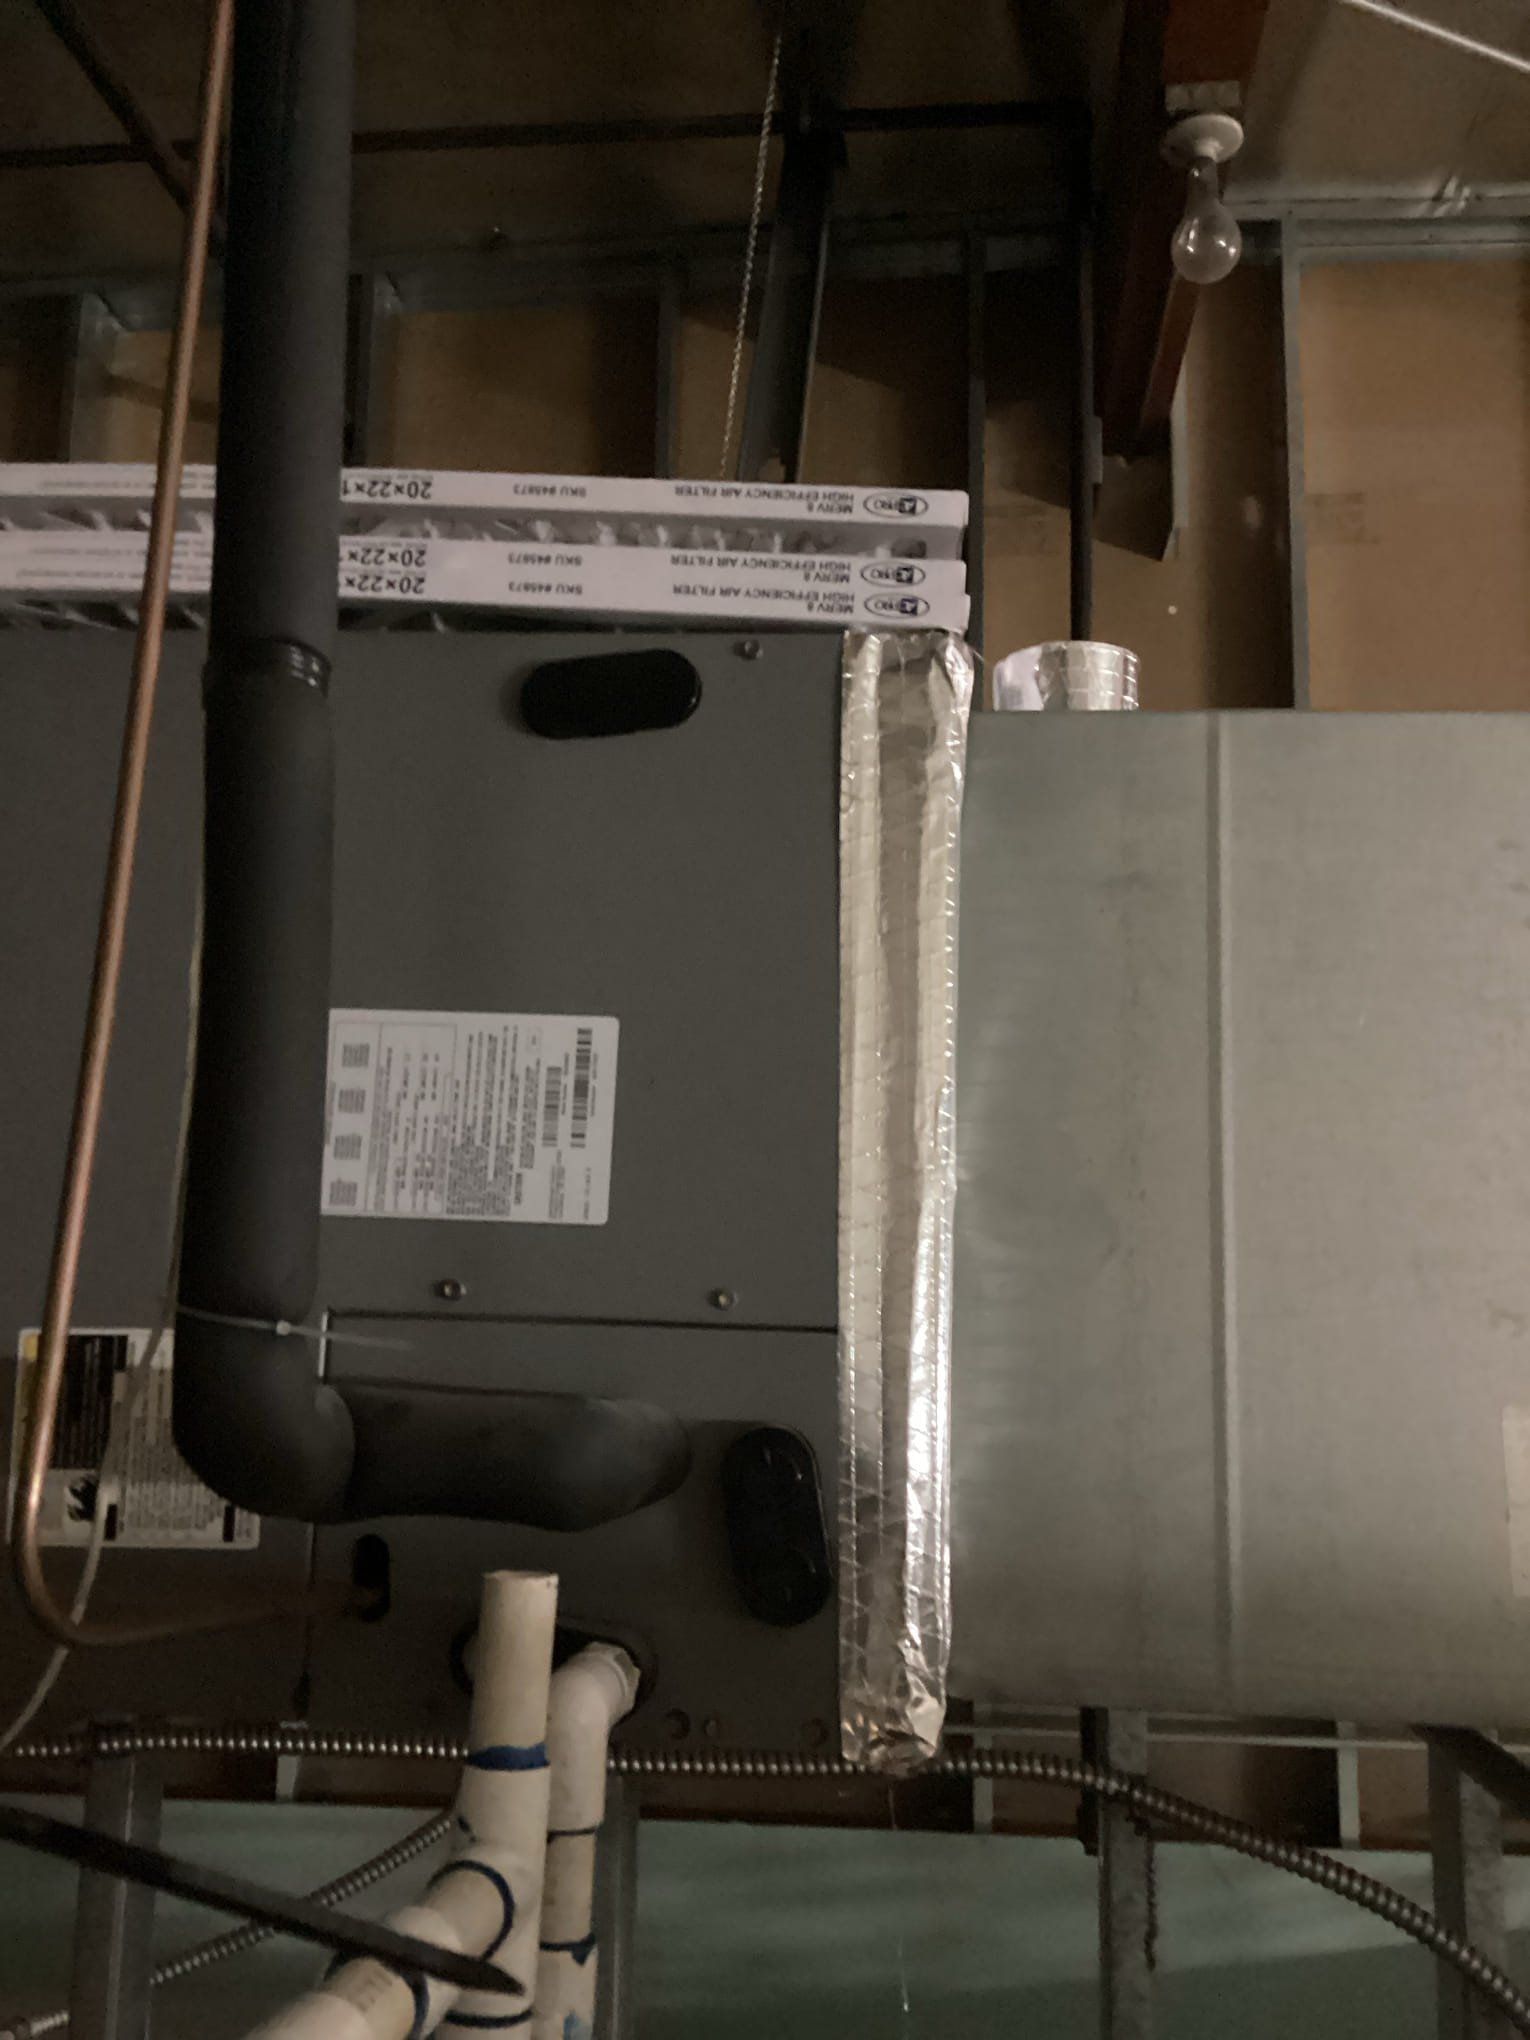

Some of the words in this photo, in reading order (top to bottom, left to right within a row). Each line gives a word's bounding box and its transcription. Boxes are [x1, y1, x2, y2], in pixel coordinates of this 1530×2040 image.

[559, 486, 587, 497] SKU
[675, 485, 717, 497] FILTER
[721, 487, 742, 498] AIR
[746, 488, 819, 501] EFFICIENCY
[823, 492, 854, 503] HIGH
[817, 502, 853, 514] MERV
[555, 555, 582, 566] SKU
[670, 554, 713, 567] FILTER
[717, 557, 738, 568] AIR
[743, 558, 816, 572] EFFICIENCY
[819, 561, 852, 573] HIGH
[814, 572, 850, 584] MERV
[555, 583, 583, 595] SKU
[672, 584, 716, 596] FILTER
[720, 586, 741, 597] AIR
[745, 588, 819, 602] EFFICIENCY
[823, 592, 855, 603] HIGH
[817, 602, 854, 614] MERV
